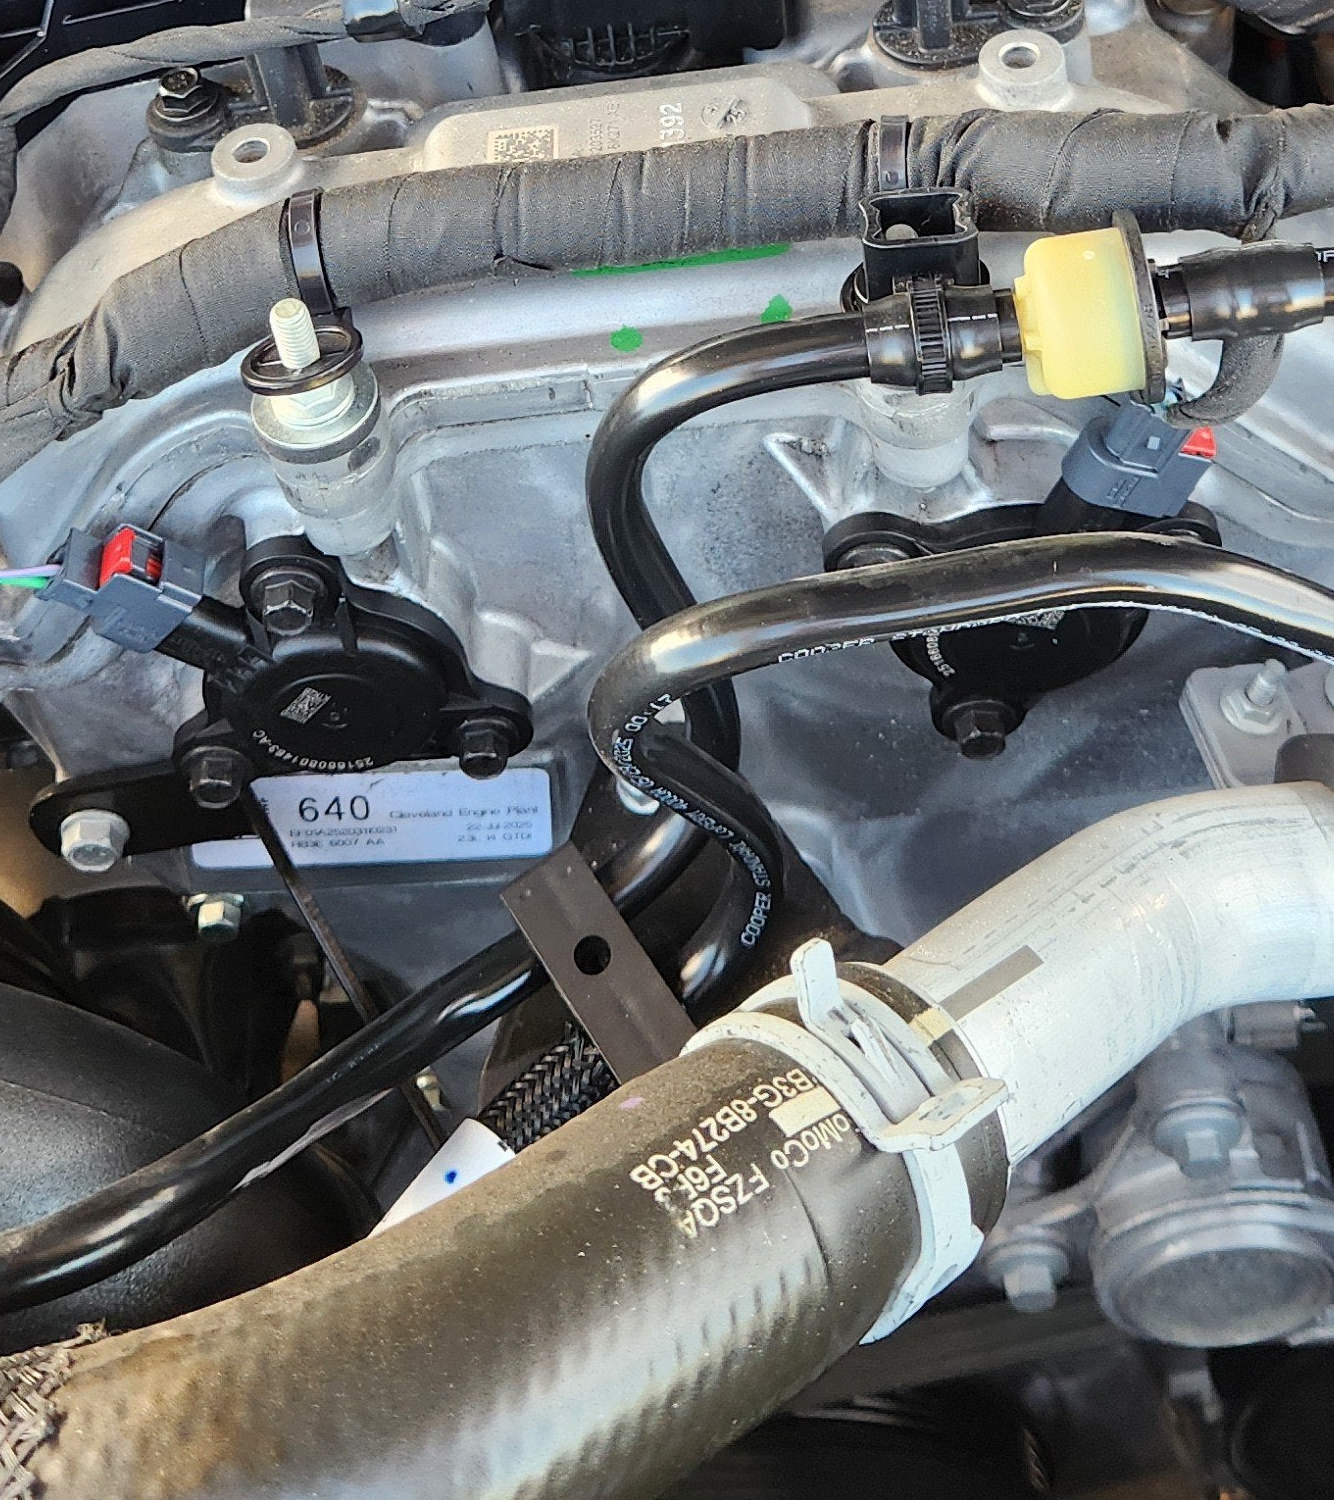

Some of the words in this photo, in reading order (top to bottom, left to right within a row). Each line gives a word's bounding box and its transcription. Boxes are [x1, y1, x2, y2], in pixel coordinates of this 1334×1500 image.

[298, 794, 371, 823] 640
[388, 808, 454, 820] Cleveland
[458, 806, 502, 818] Engine
[629, 1067, 819, 1192] B3G-8B274-CB
[770, 1112, 851, 1171] oMoCo
